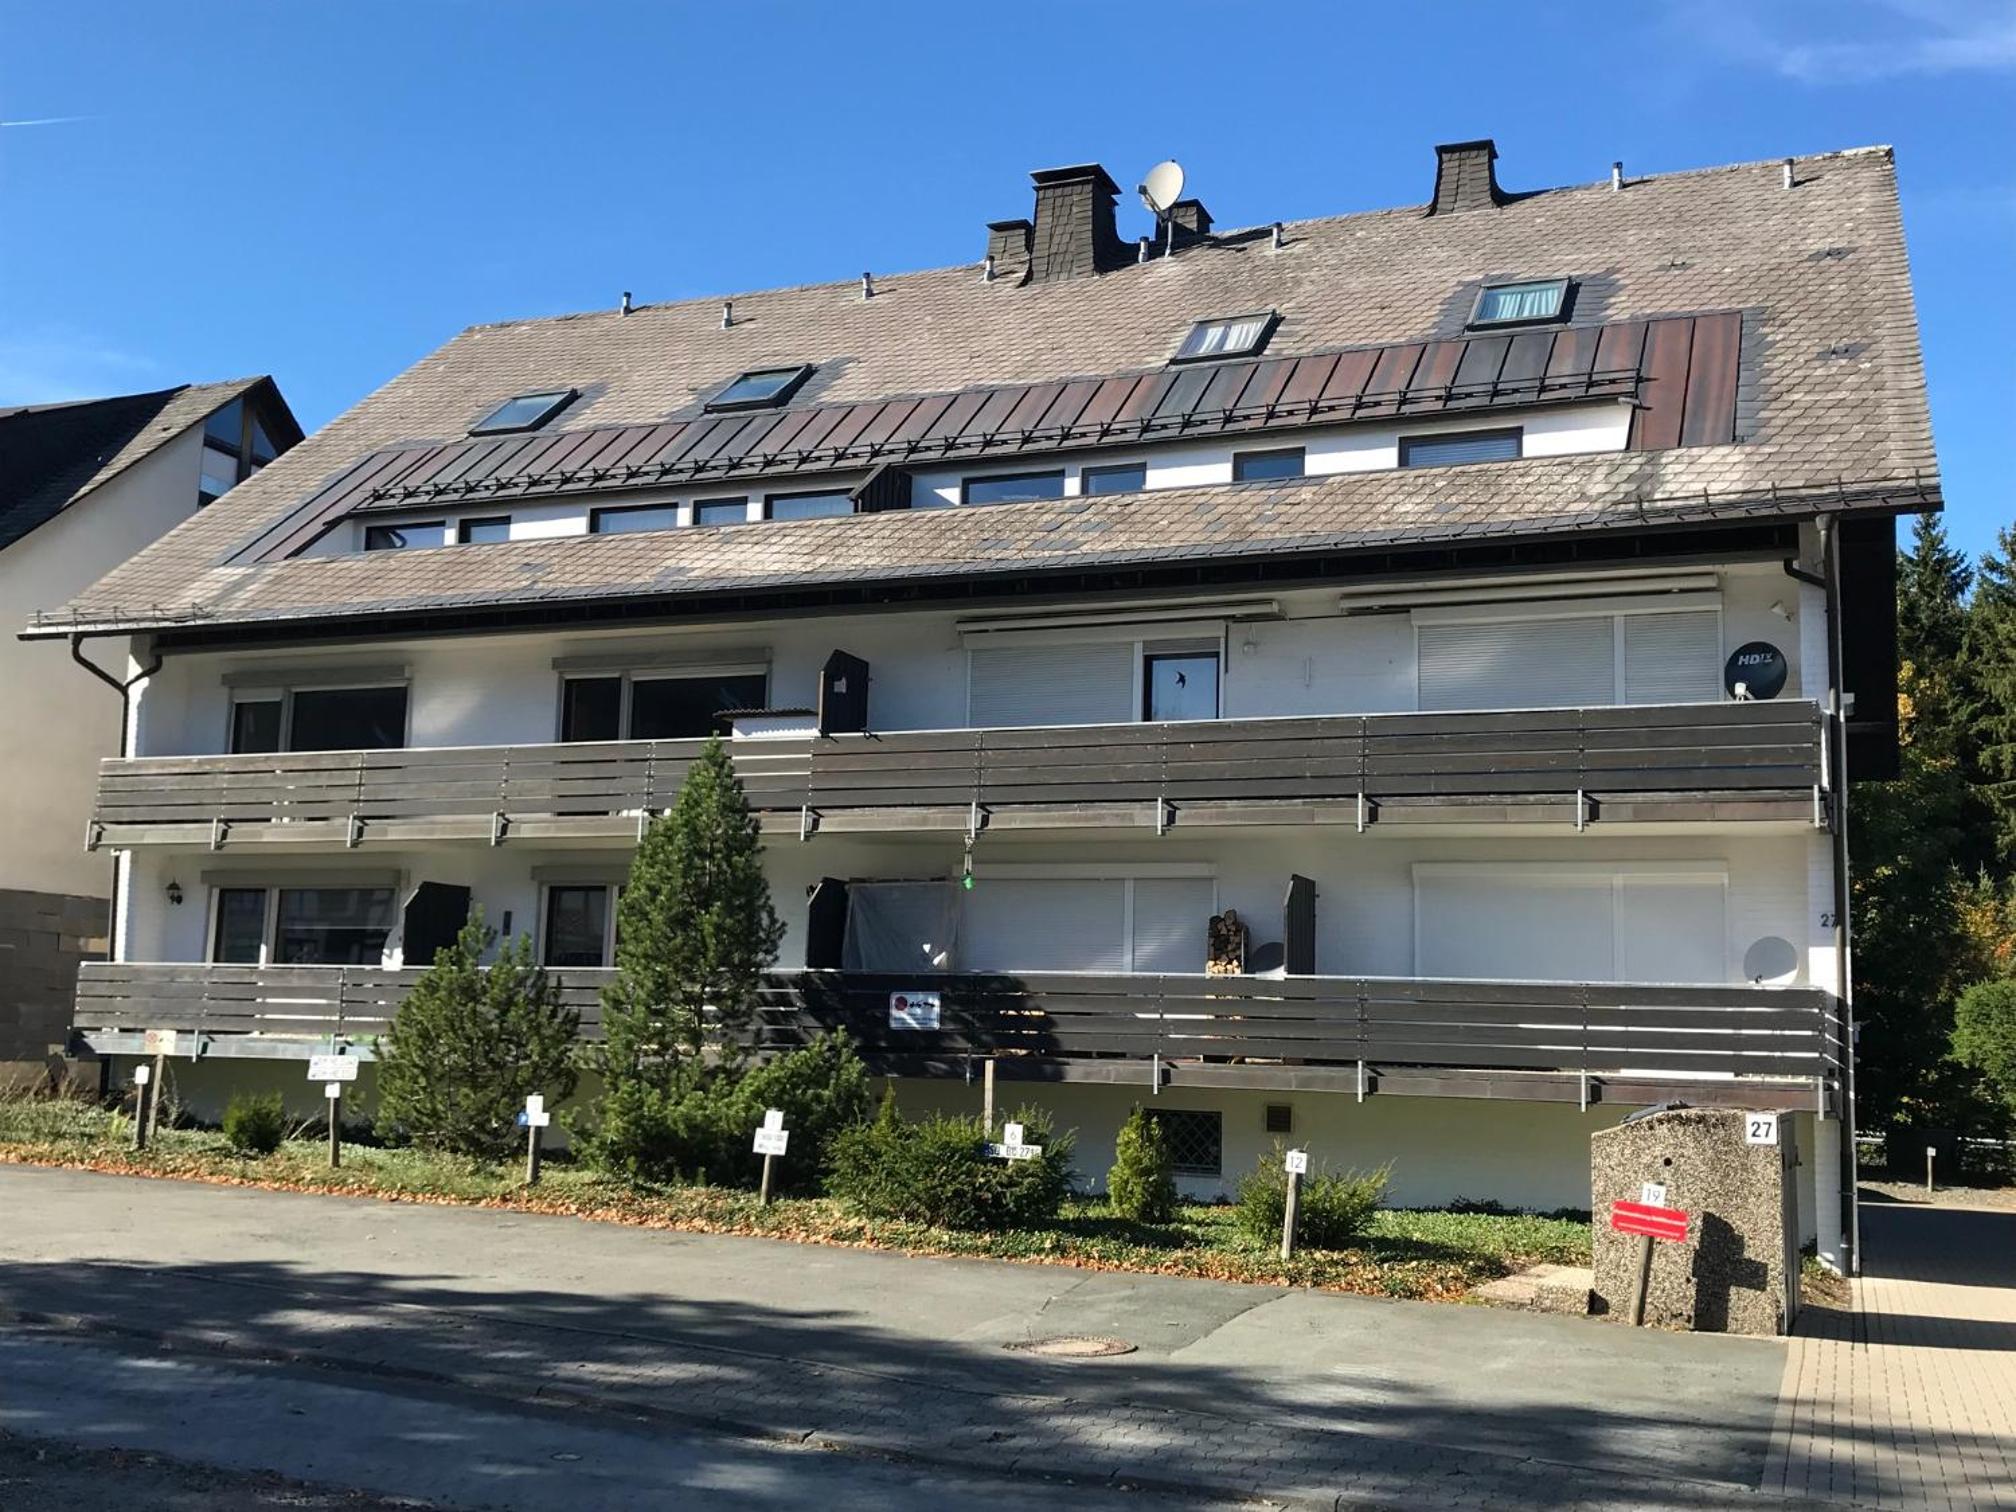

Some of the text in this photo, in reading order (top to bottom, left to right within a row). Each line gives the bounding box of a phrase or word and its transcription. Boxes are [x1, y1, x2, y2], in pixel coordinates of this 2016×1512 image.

[1010, 1131, 1017, 1140] 6
[1751, 1121, 1772, 1138] 27
[1290, 1156, 1303, 1169] 12
[1646, 1188, 1660, 1202] 19
